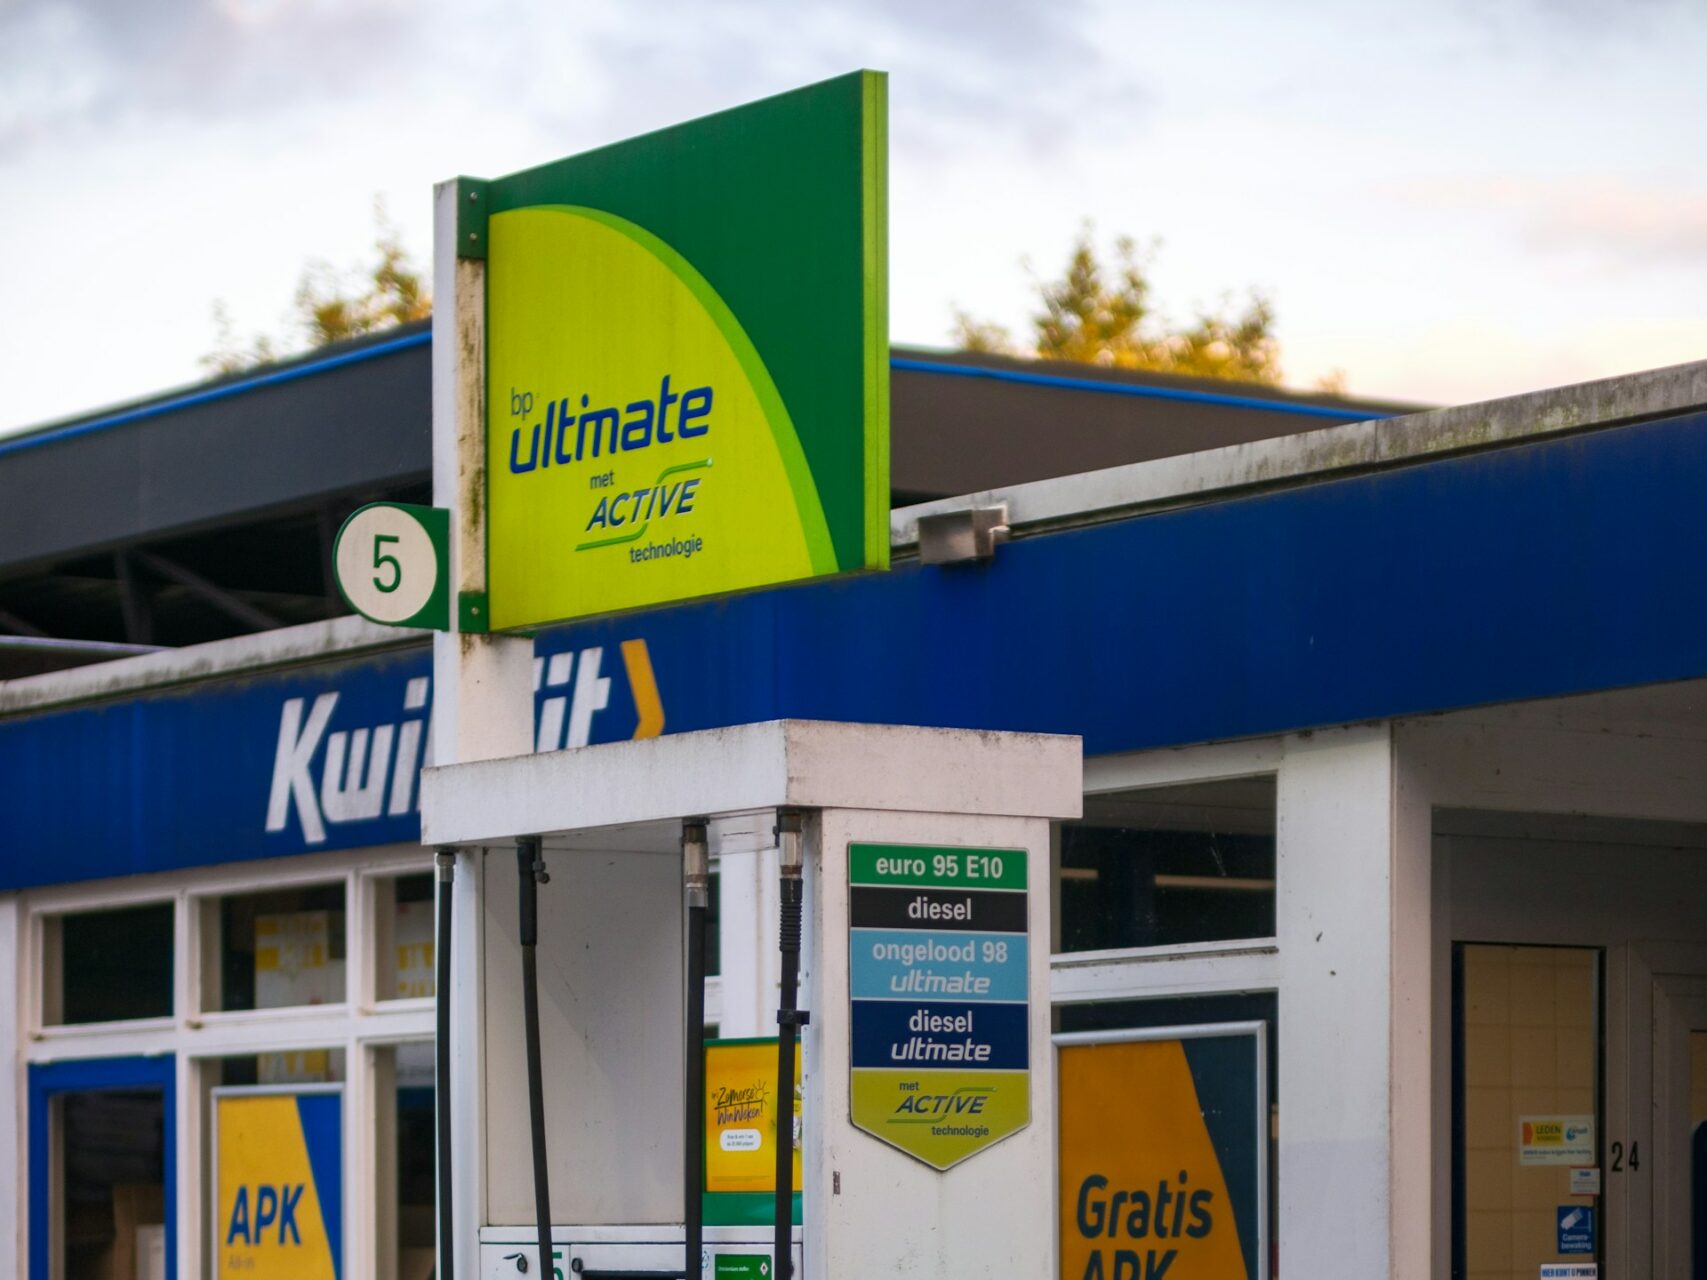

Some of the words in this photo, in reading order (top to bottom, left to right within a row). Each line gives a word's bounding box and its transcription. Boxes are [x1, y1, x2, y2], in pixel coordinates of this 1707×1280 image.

[510, 386, 534, 420] bp
[509, 374, 713, 474] ultimate
[590, 469, 614, 490] met
[586, 478, 702, 532] ACTIVE
[630, 534, 703, 563] technologie
[373, 534, 401, 593] 5
[265, 677, 434, 844] Kwi
[876, 857, 926, 876] euro
[932, 855, 959, 877] 95
[966, 855, 1003, 879] E10
[908, 896, 972, 920] diesel
[872, 939, 975, 966] ongelood
[982, 941, 1008, 963] 98
[890, 969, 990, 994] ultimate
[909, 1009, 972, 1032] diesel
[891, 1037, 991, 1061] ultimate
[899, 1081, 919, 1091] met
[895, 1095, 987, 1114] ACTIVE
[931, 1125, 989, 1138] technologie
[226, 1183, 304, 1246] APK
[1077, 1169, 1214, 1239] Gratis
